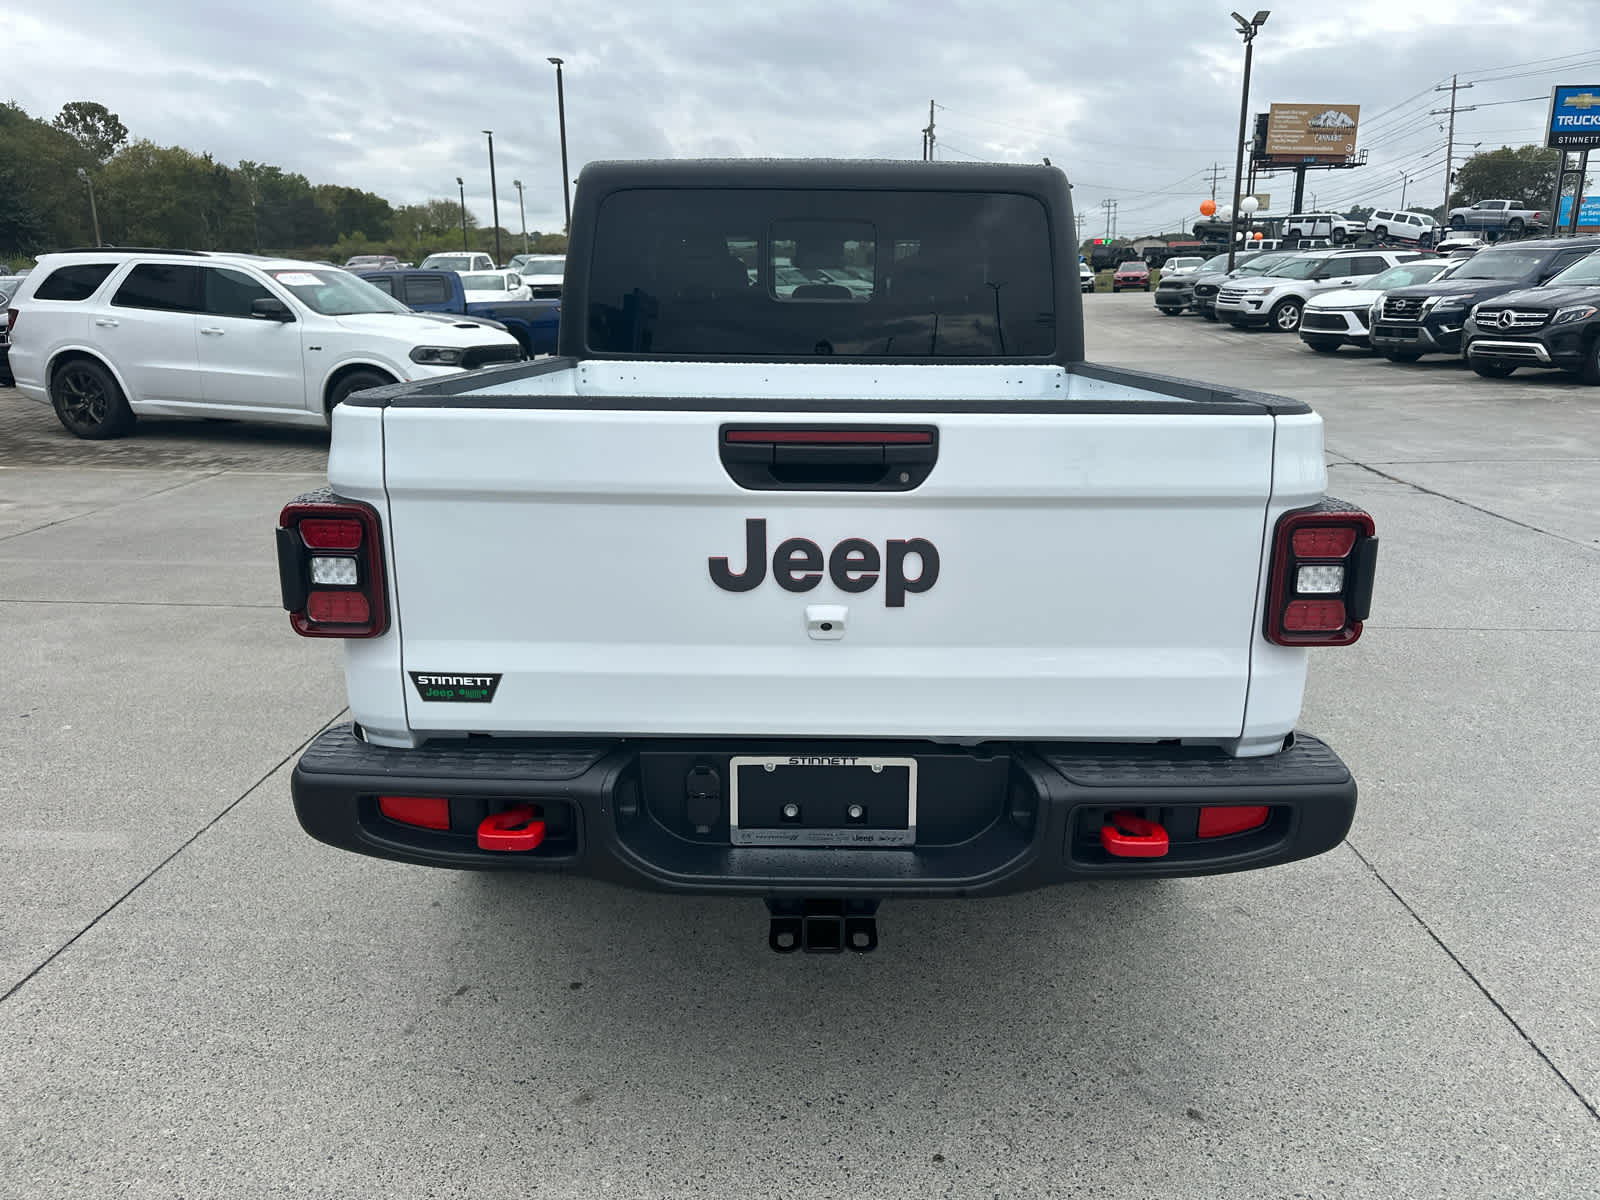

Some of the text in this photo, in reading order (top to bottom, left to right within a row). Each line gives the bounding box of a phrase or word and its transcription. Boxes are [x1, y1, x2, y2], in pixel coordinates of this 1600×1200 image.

[1558, 136, 1600, 144] STINNETT
[708, 518, 940, 608] Jeep
[417, 675, 493, 686] STINNETT
[425, 687, 454, 698] Jeep
[788, 757, 859, 765] STINNETT
[852, 834, 874, 843] Jeep
